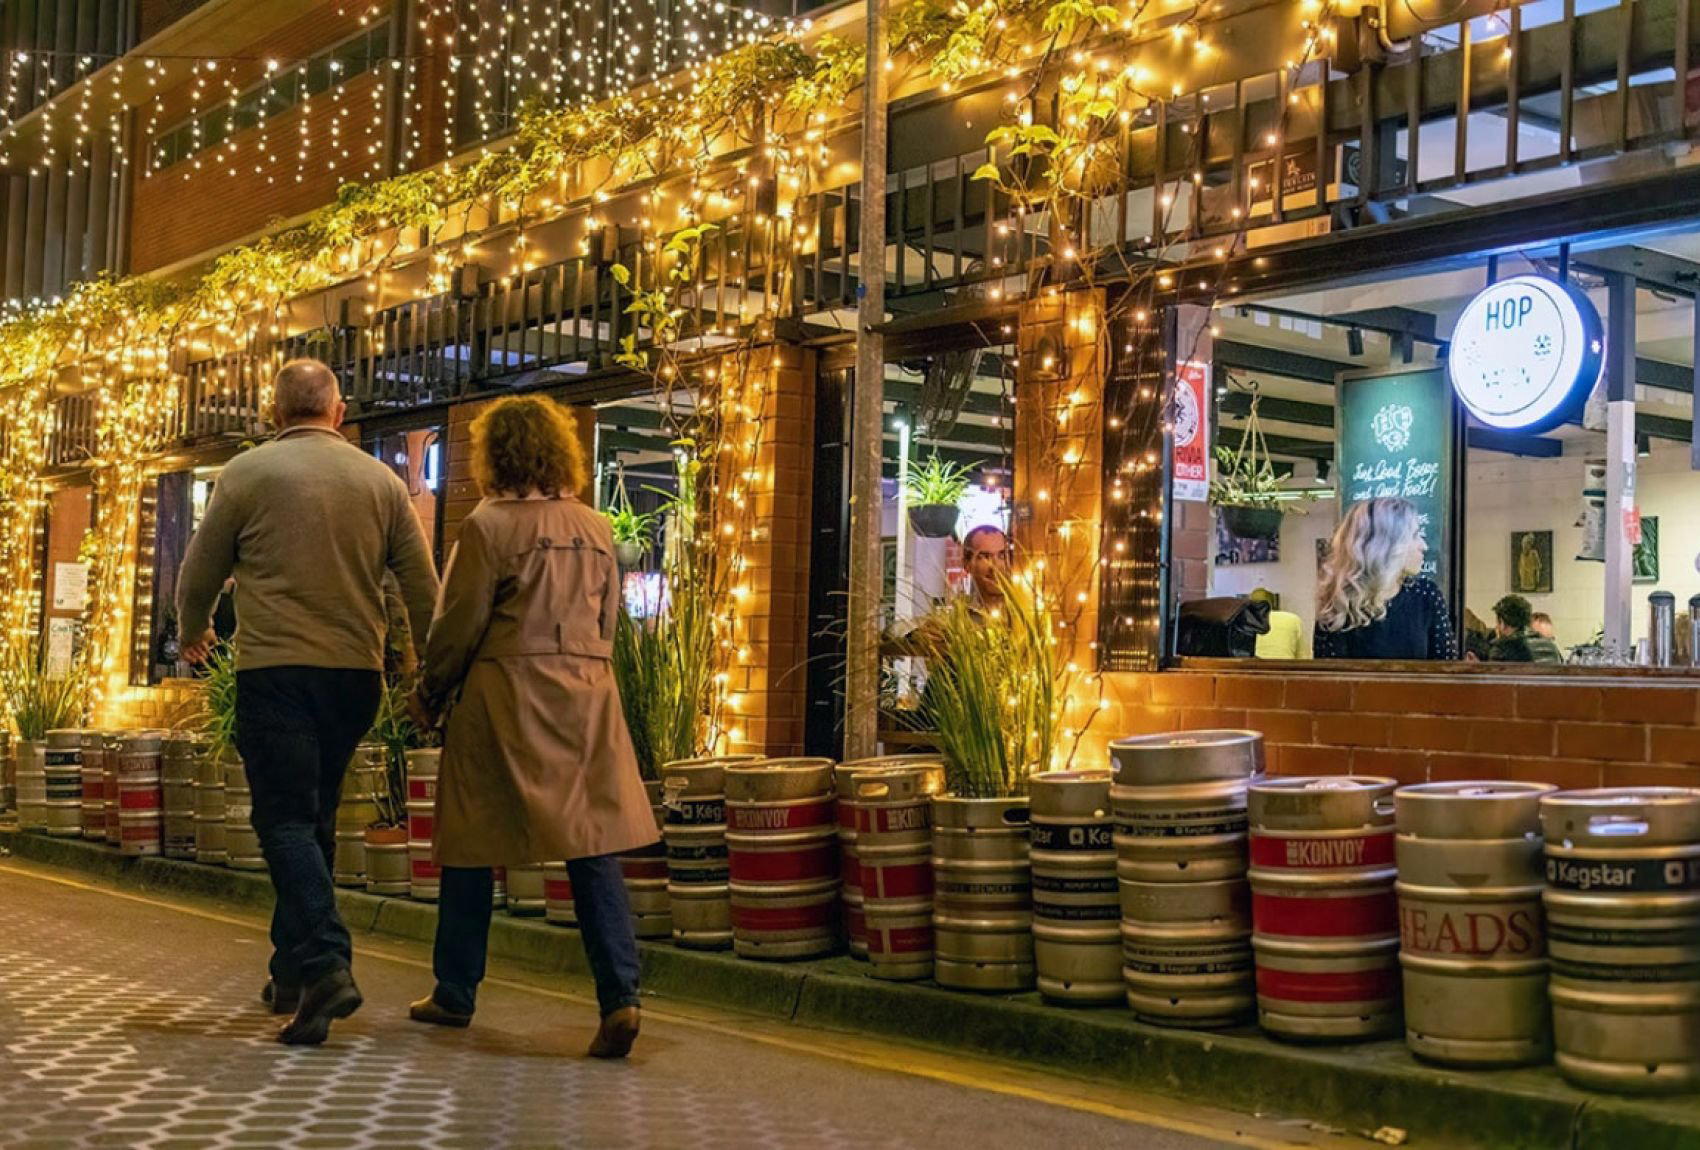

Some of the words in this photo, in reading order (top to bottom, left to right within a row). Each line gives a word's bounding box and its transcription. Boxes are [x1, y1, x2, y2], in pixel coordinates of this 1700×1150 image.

[1486, 296, 1533, 331] HOP
[1298, 838, 1366, 865] KONVOY
[1558, 861, 1636, 889] Kegstar
